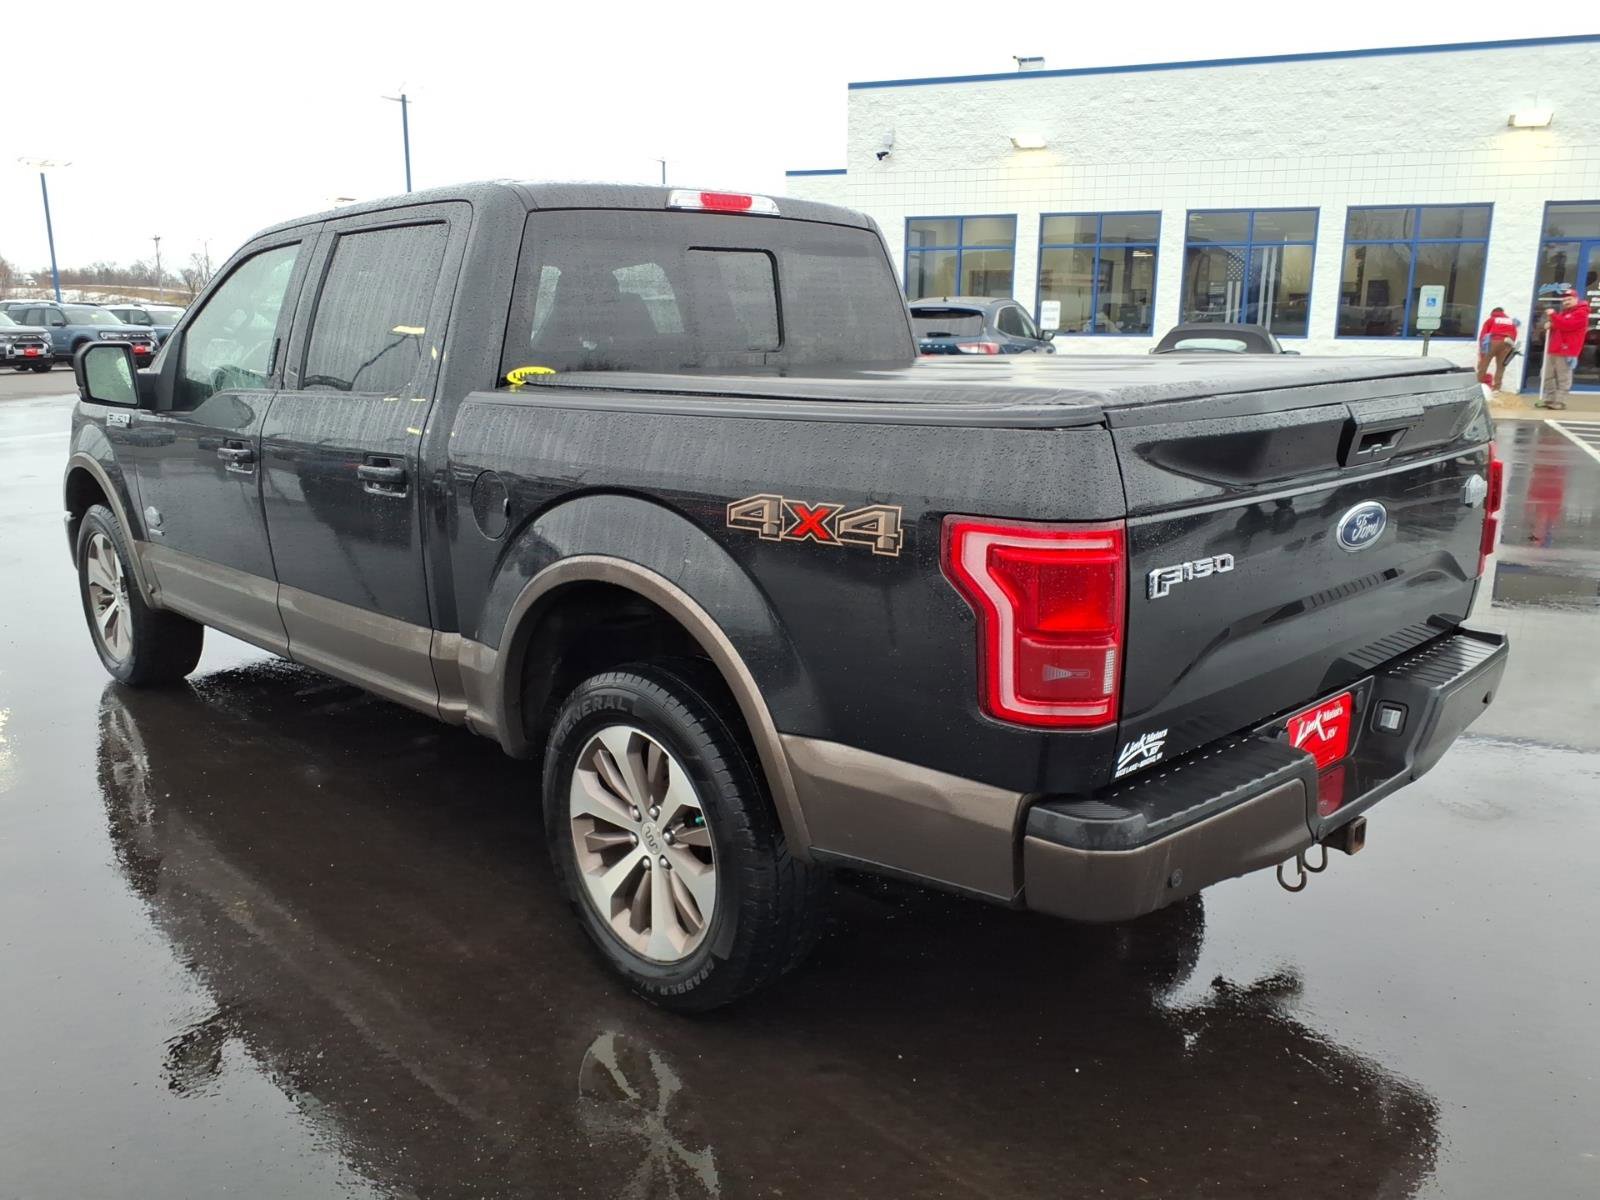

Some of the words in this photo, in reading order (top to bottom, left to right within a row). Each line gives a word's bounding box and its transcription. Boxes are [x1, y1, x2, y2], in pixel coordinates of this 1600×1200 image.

[727, 494, 903, 556] 4X4
[1351, 513, 1381, 542] Ford
[1294, 710, 1328, 748] Link
[1117, 733, 1149, 764] Link
